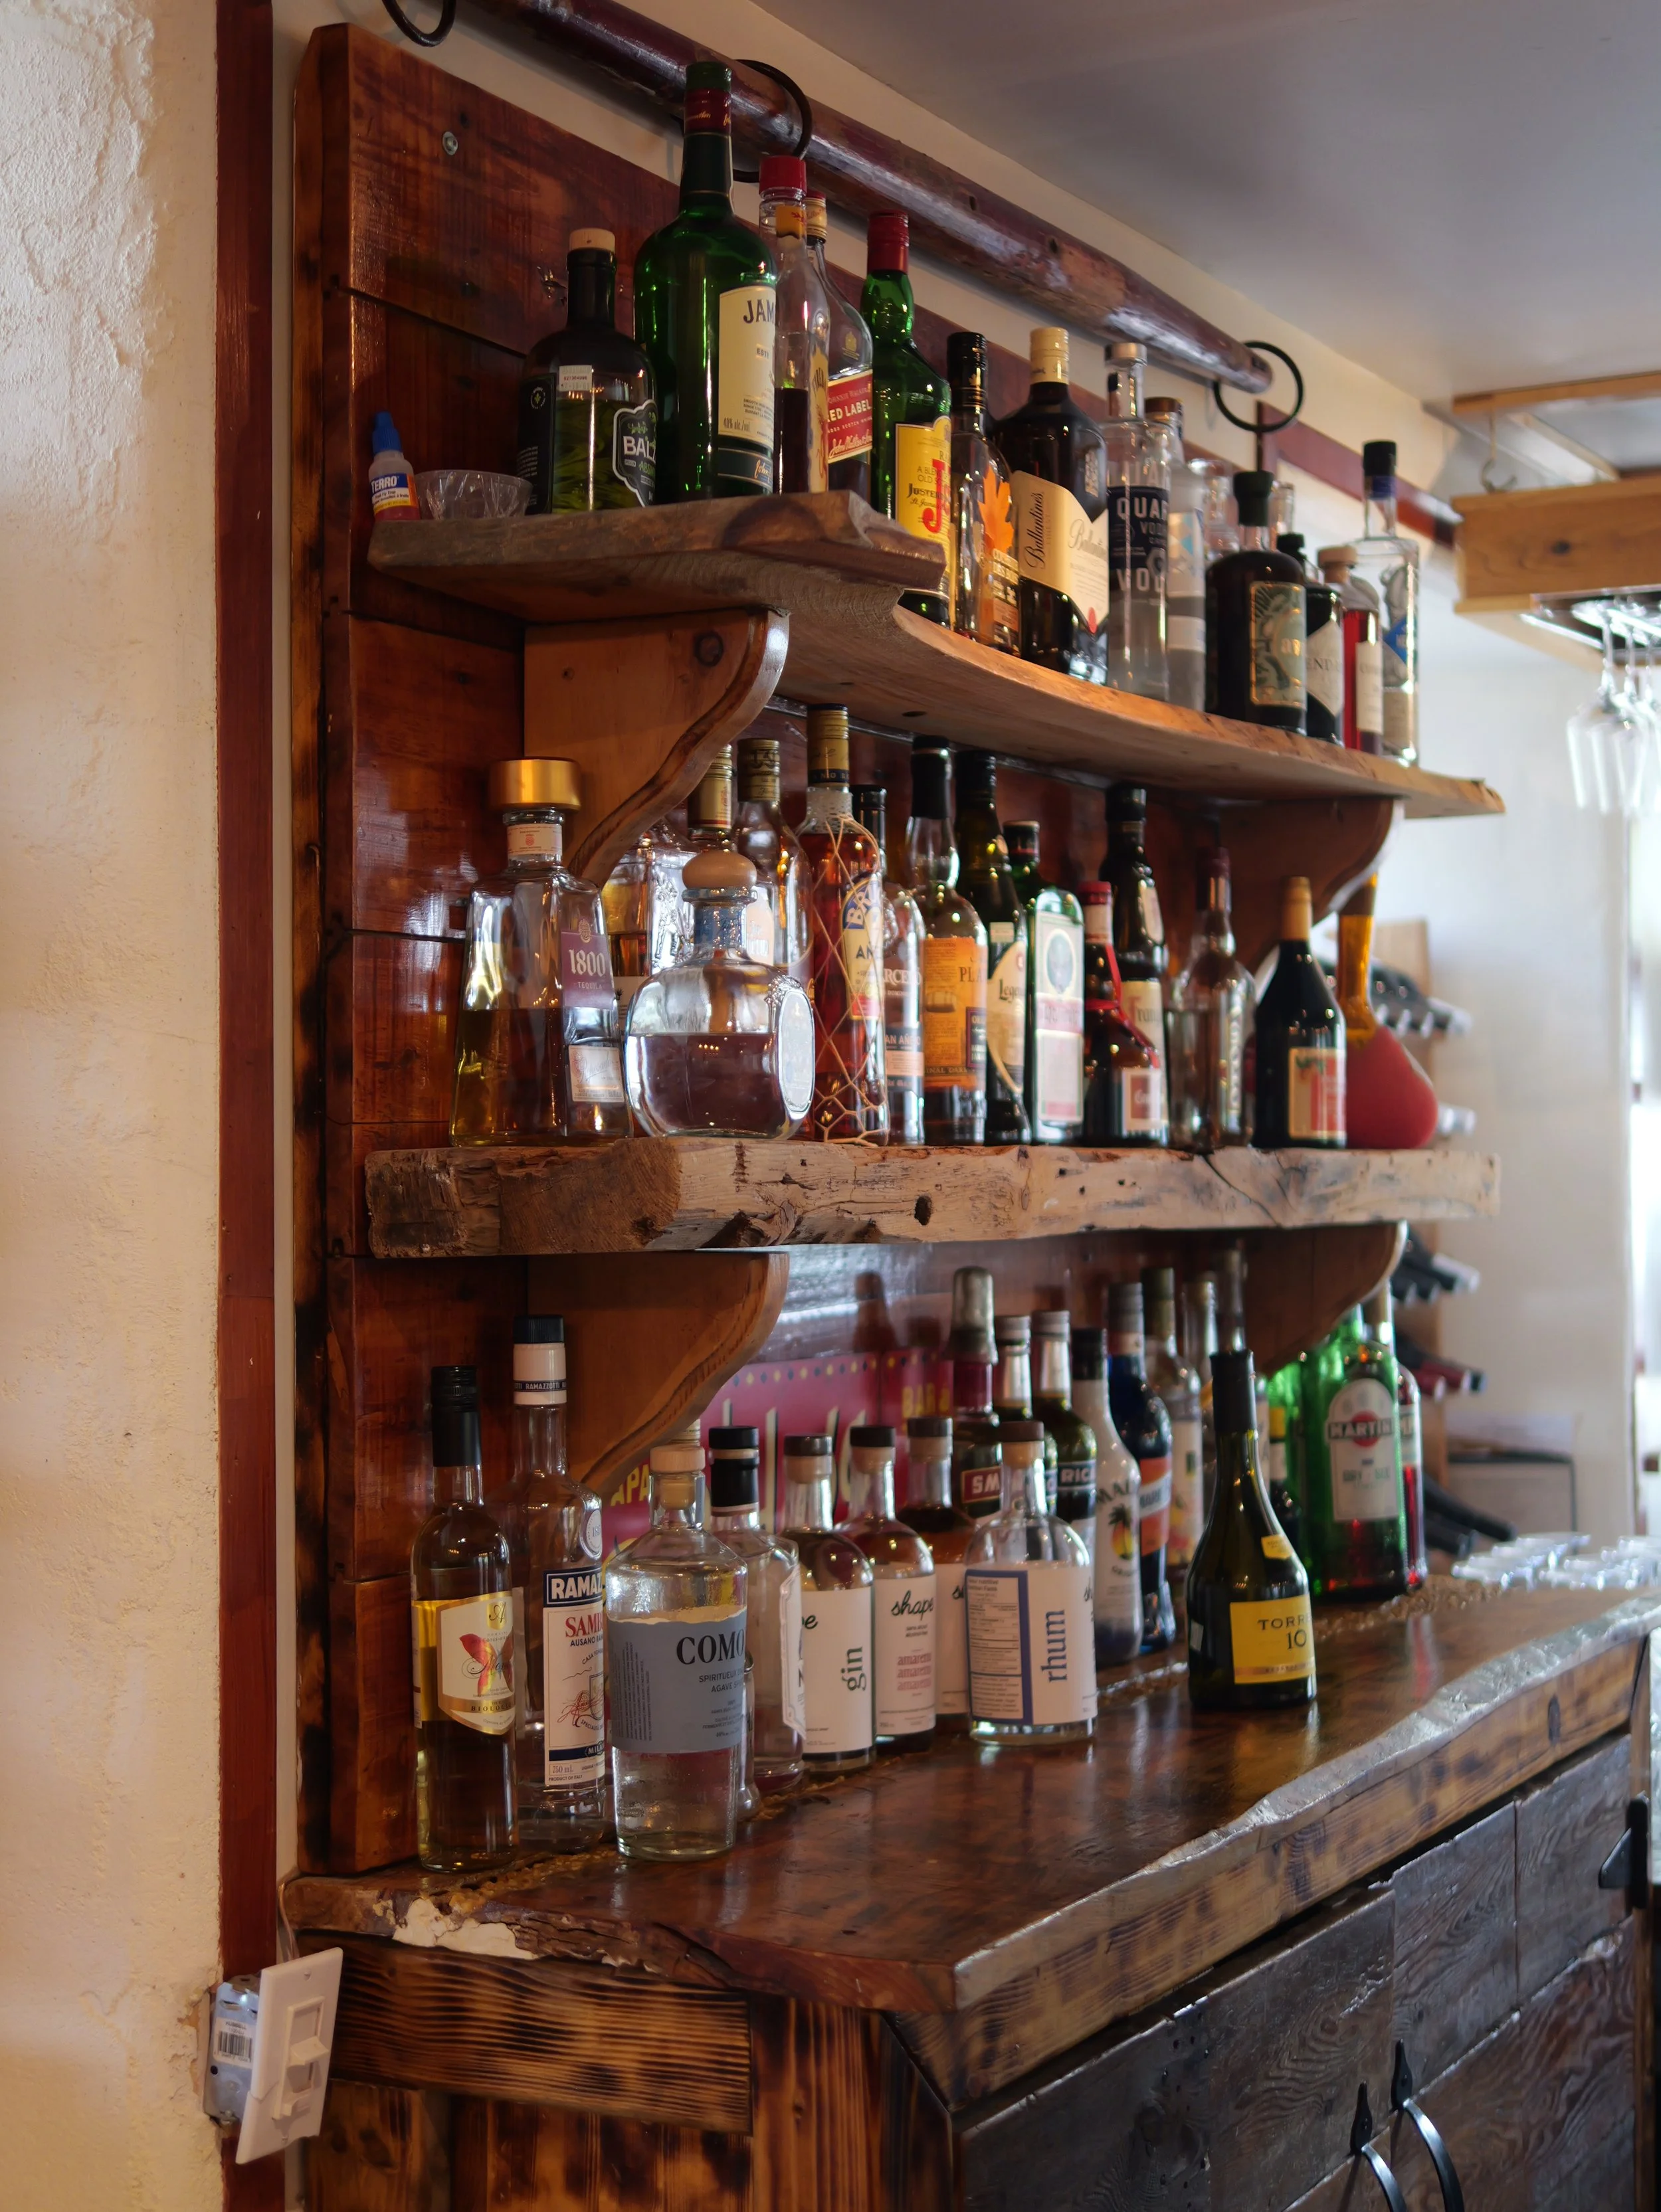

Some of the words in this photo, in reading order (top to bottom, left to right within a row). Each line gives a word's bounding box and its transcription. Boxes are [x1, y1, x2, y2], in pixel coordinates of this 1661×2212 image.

[844, 399, 872, 417] LABEL
[371, 475, 397, 494] TERRO
[1024, 492, 1046, 570] Ballantine's
[568, 948, 607, 978] 1800
[577, 981, 603, 990] TEQUILA
[526, 1382, 560, 1390] RAMAZZOTTI
[570, 1637, 596, 1647] AUSANO
[1040, 1609, 1068, 1683] rhum
[581, 1653, 594, 1665] CASA
[841, 1645, 867, 1692] gin
[711, 1682, 733, 1693] AGAVE
[552, 1765, 563, 1774] 750
